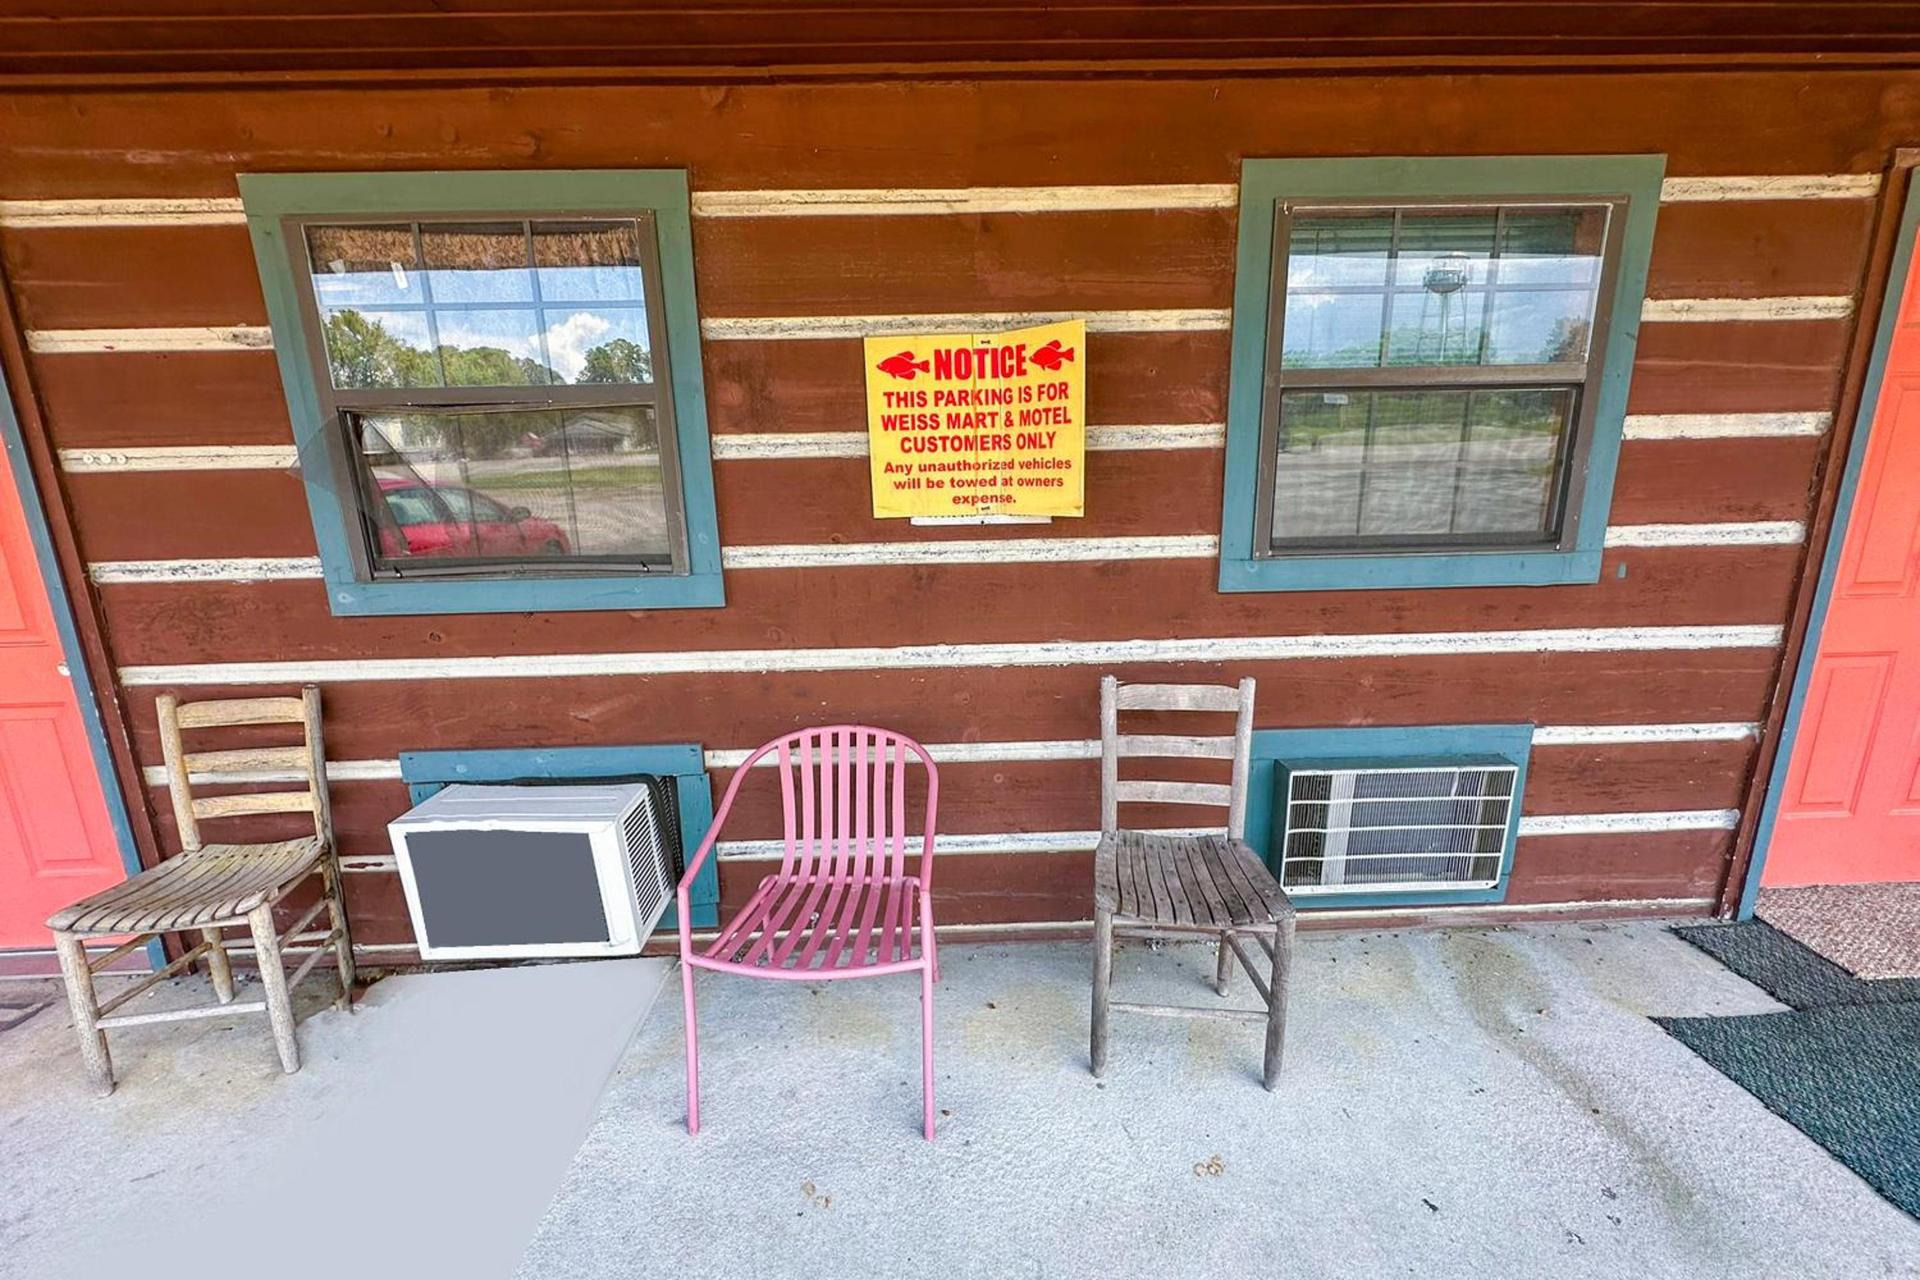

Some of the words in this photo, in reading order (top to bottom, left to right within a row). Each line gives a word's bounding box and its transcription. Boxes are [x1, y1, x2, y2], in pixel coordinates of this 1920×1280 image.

[934, 344, 1027, 380] NOTICE
[883, 391, 927, 408] THIS
[934, 387, 1013, 407] PARKING
[1018, 386, 1032, 403] IS
[1038, 382, 1069, 402] FOR
[881, 414, 940, 431] WEISS
[947, 412, 998, 429] MART
[1004, 411, 1014, 427] &
[1019, 407, 1071, 426] MOTEL
[900, 434, 1011, 453] CUSTOMERS
[1016, 431, 1056, 449] ONLY
[884, 462, 912, 475] Any
[918, 459, 1014, 472] unauthorized
[1018, 457, 1071, 469] vehicles
[893, 478, 920, 489] will
[926, 478, 944, 489] be
[950, 476, 997, 487] towed
[1002, 476, 1013, 486] at
[1017, 476, 1063, 487] owners
[952, 494, 1016, 506] expense.
